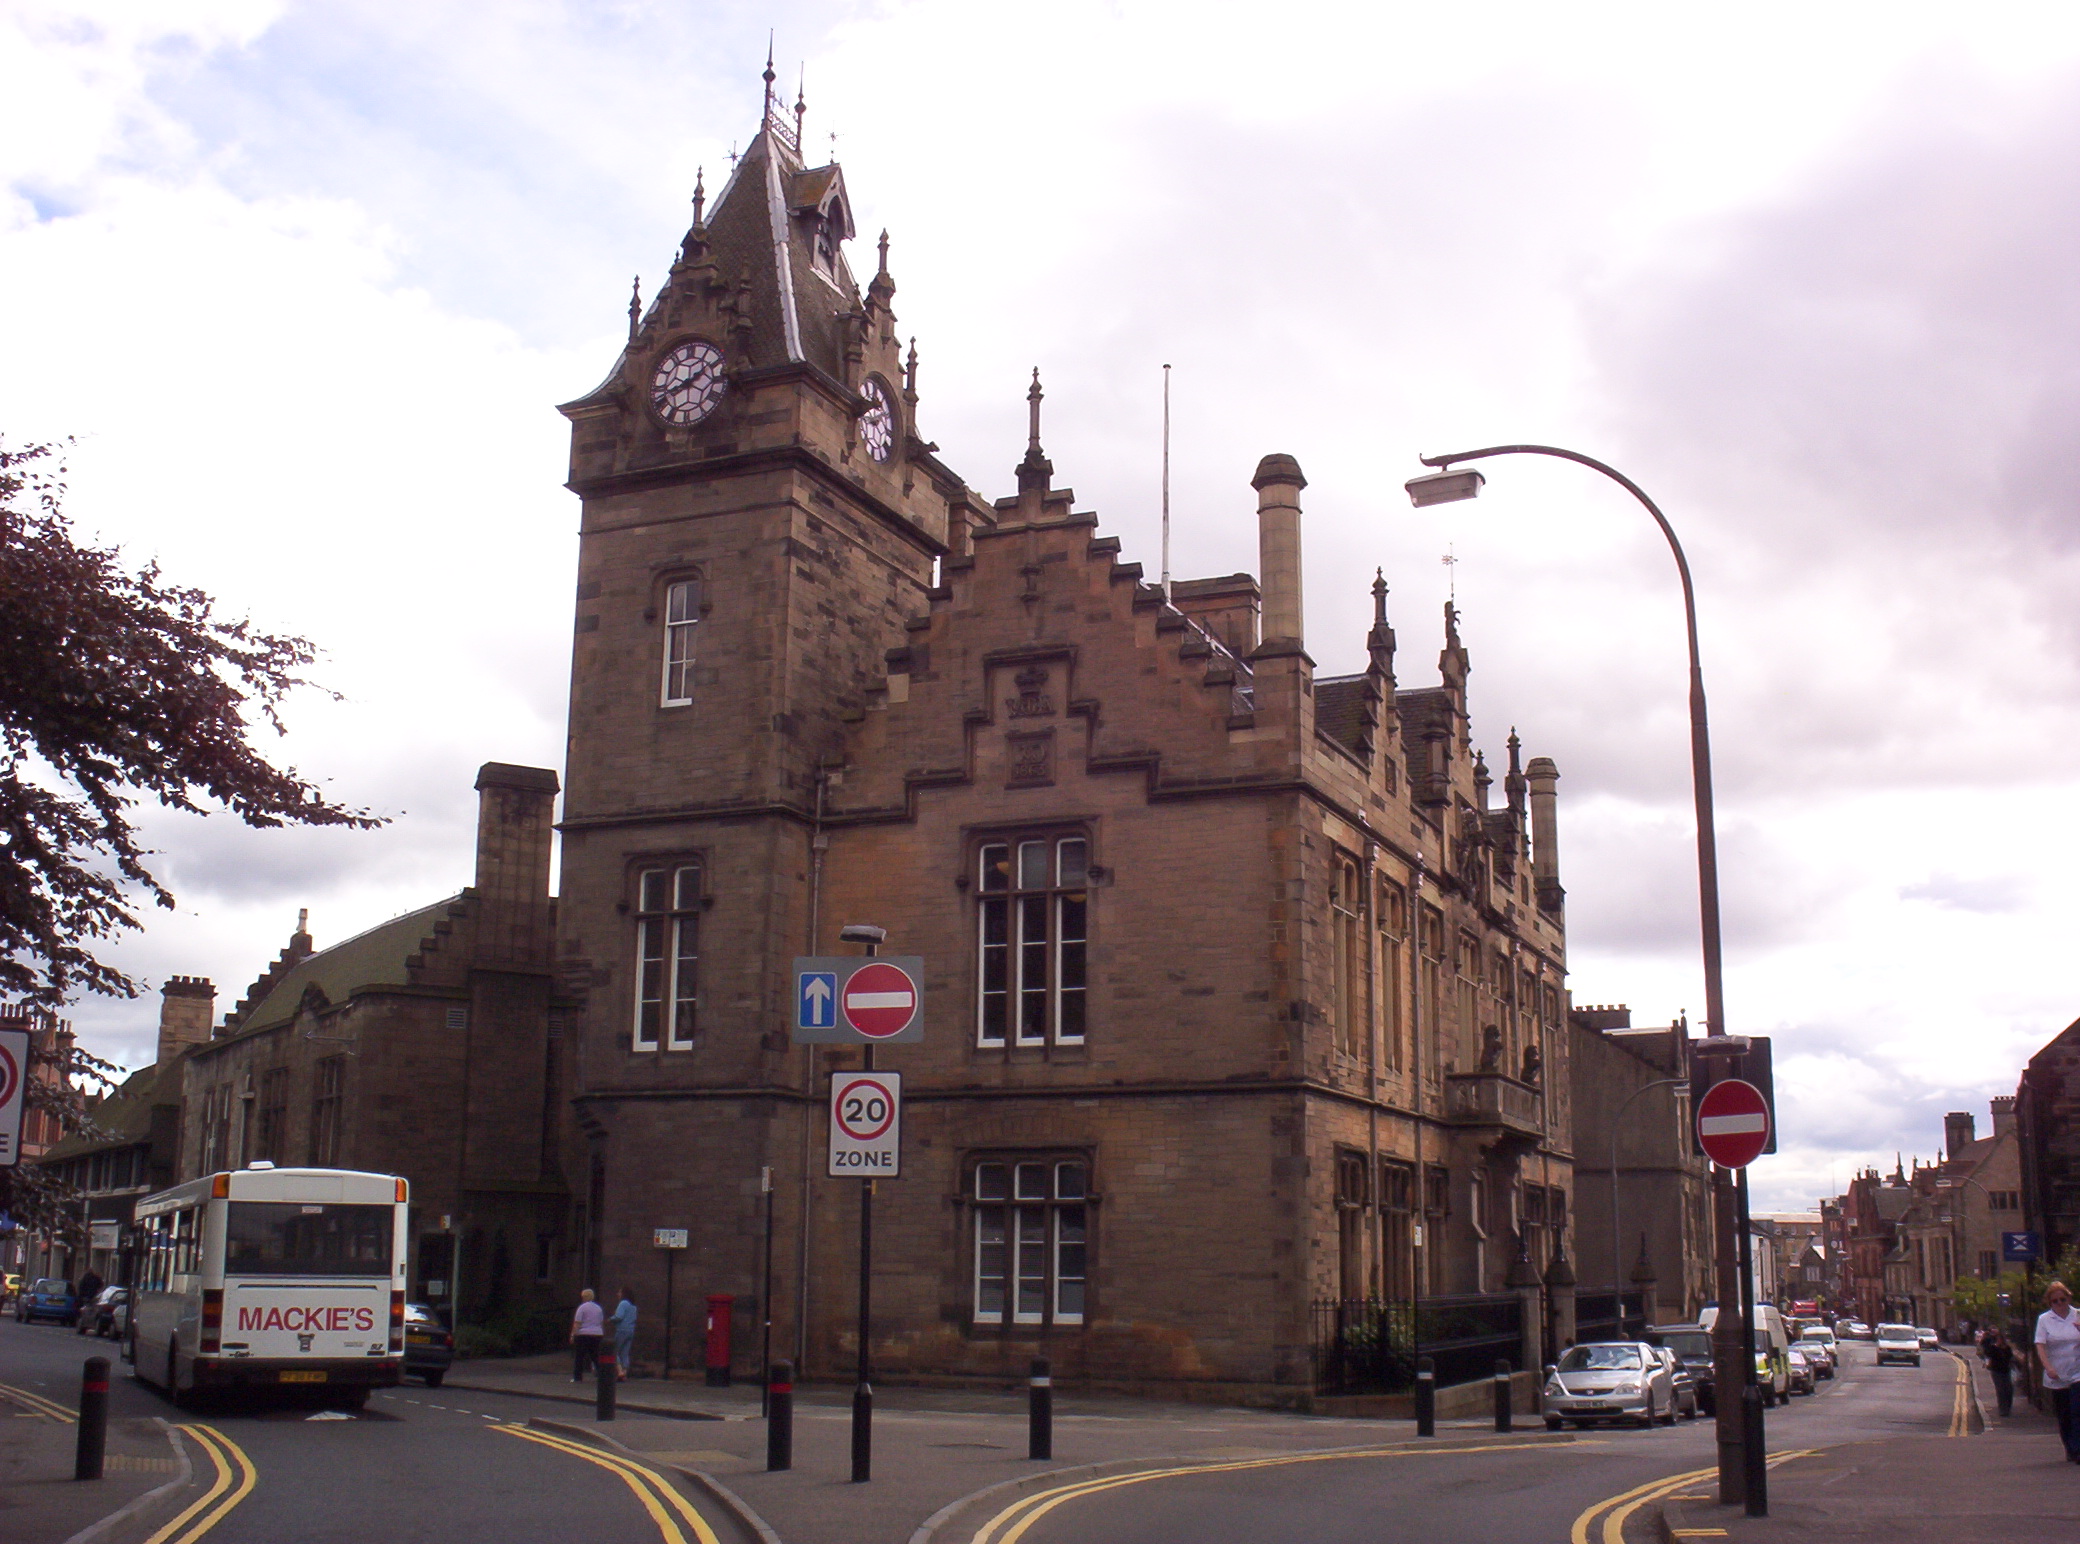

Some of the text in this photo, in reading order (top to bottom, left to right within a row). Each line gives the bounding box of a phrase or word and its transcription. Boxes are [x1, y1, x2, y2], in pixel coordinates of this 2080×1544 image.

[846, 1098, 886, 1122] 20
[836, 1151, 892, 1166] ZONE
[239, 1307, 374, 1331] MACKIE'S
